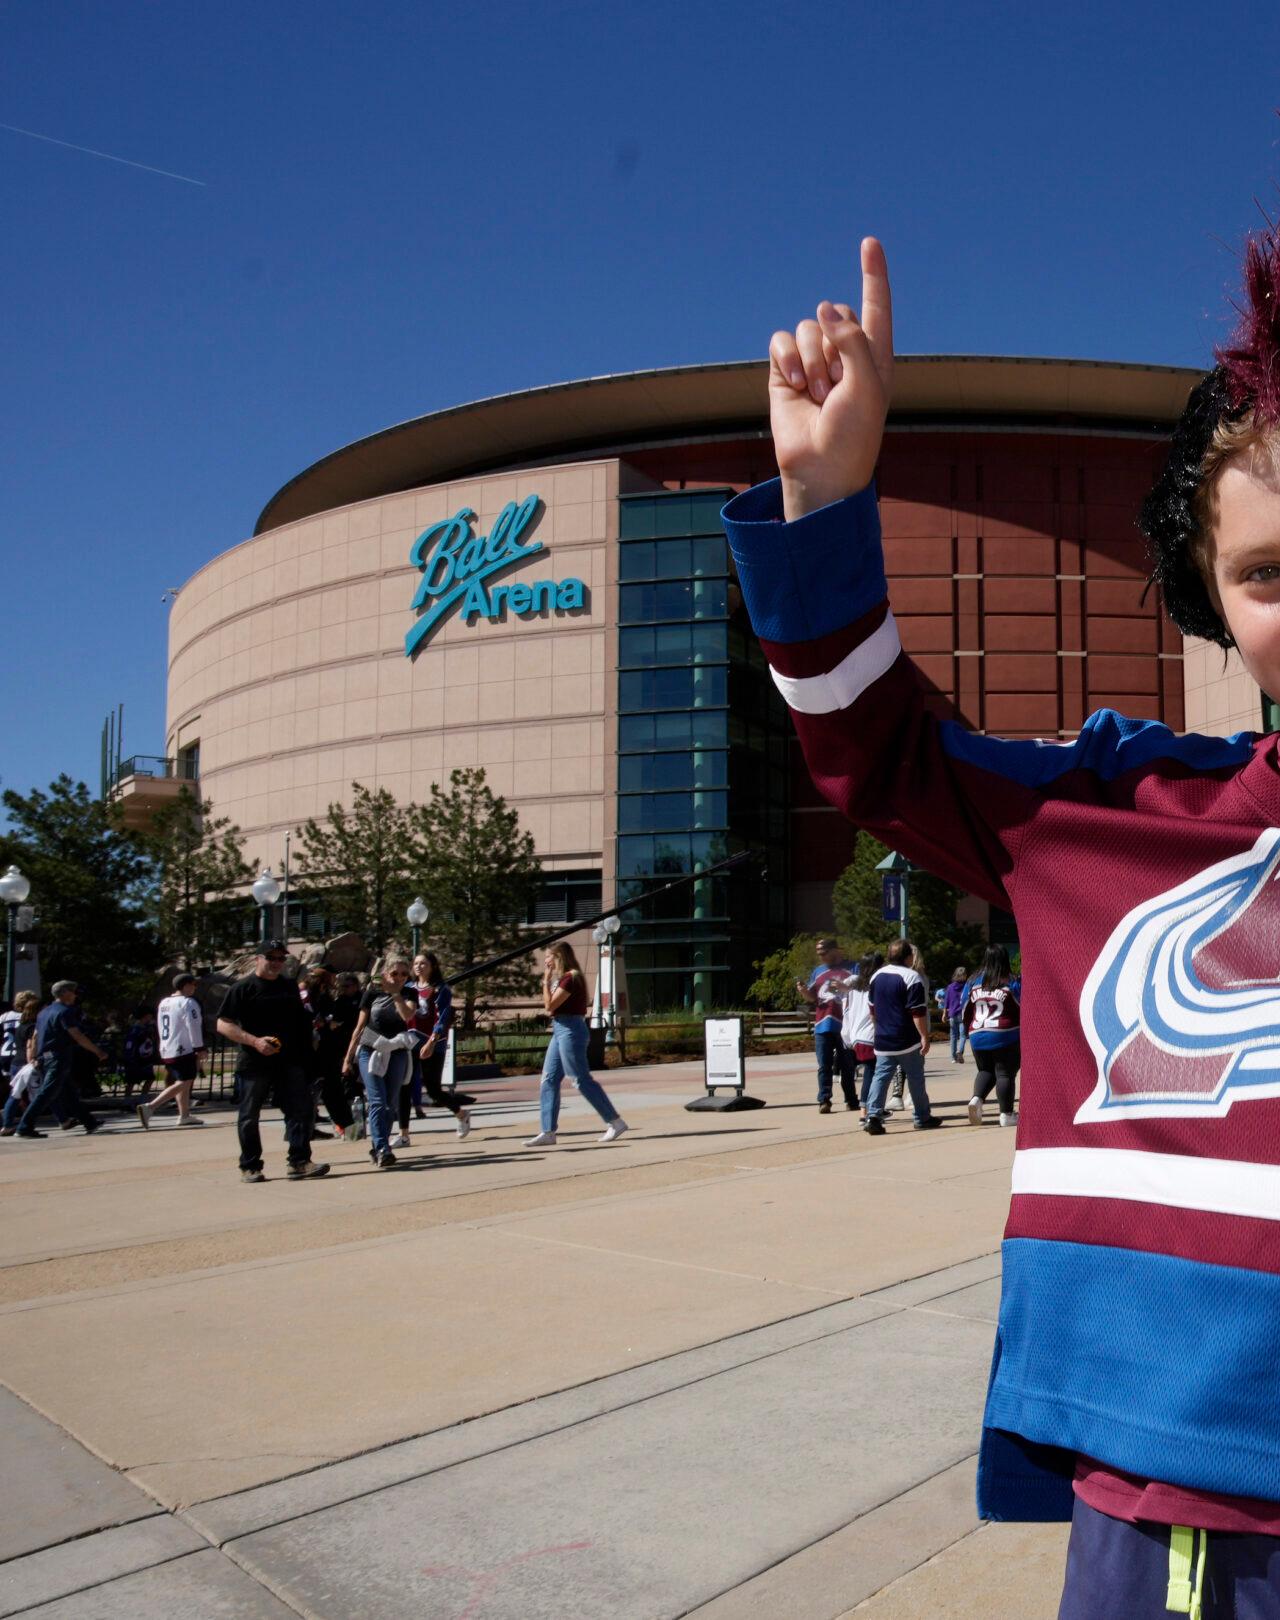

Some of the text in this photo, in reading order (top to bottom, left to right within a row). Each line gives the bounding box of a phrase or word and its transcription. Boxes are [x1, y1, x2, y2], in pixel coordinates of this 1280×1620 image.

[405, 494, 543, 657] Ball
[459, 577, 584, 620] Arena
[162, 1014, 170, 1040] 8
[973, 1000, 1004, 1029] 92
[1, 1031, 17, 1056] 2
